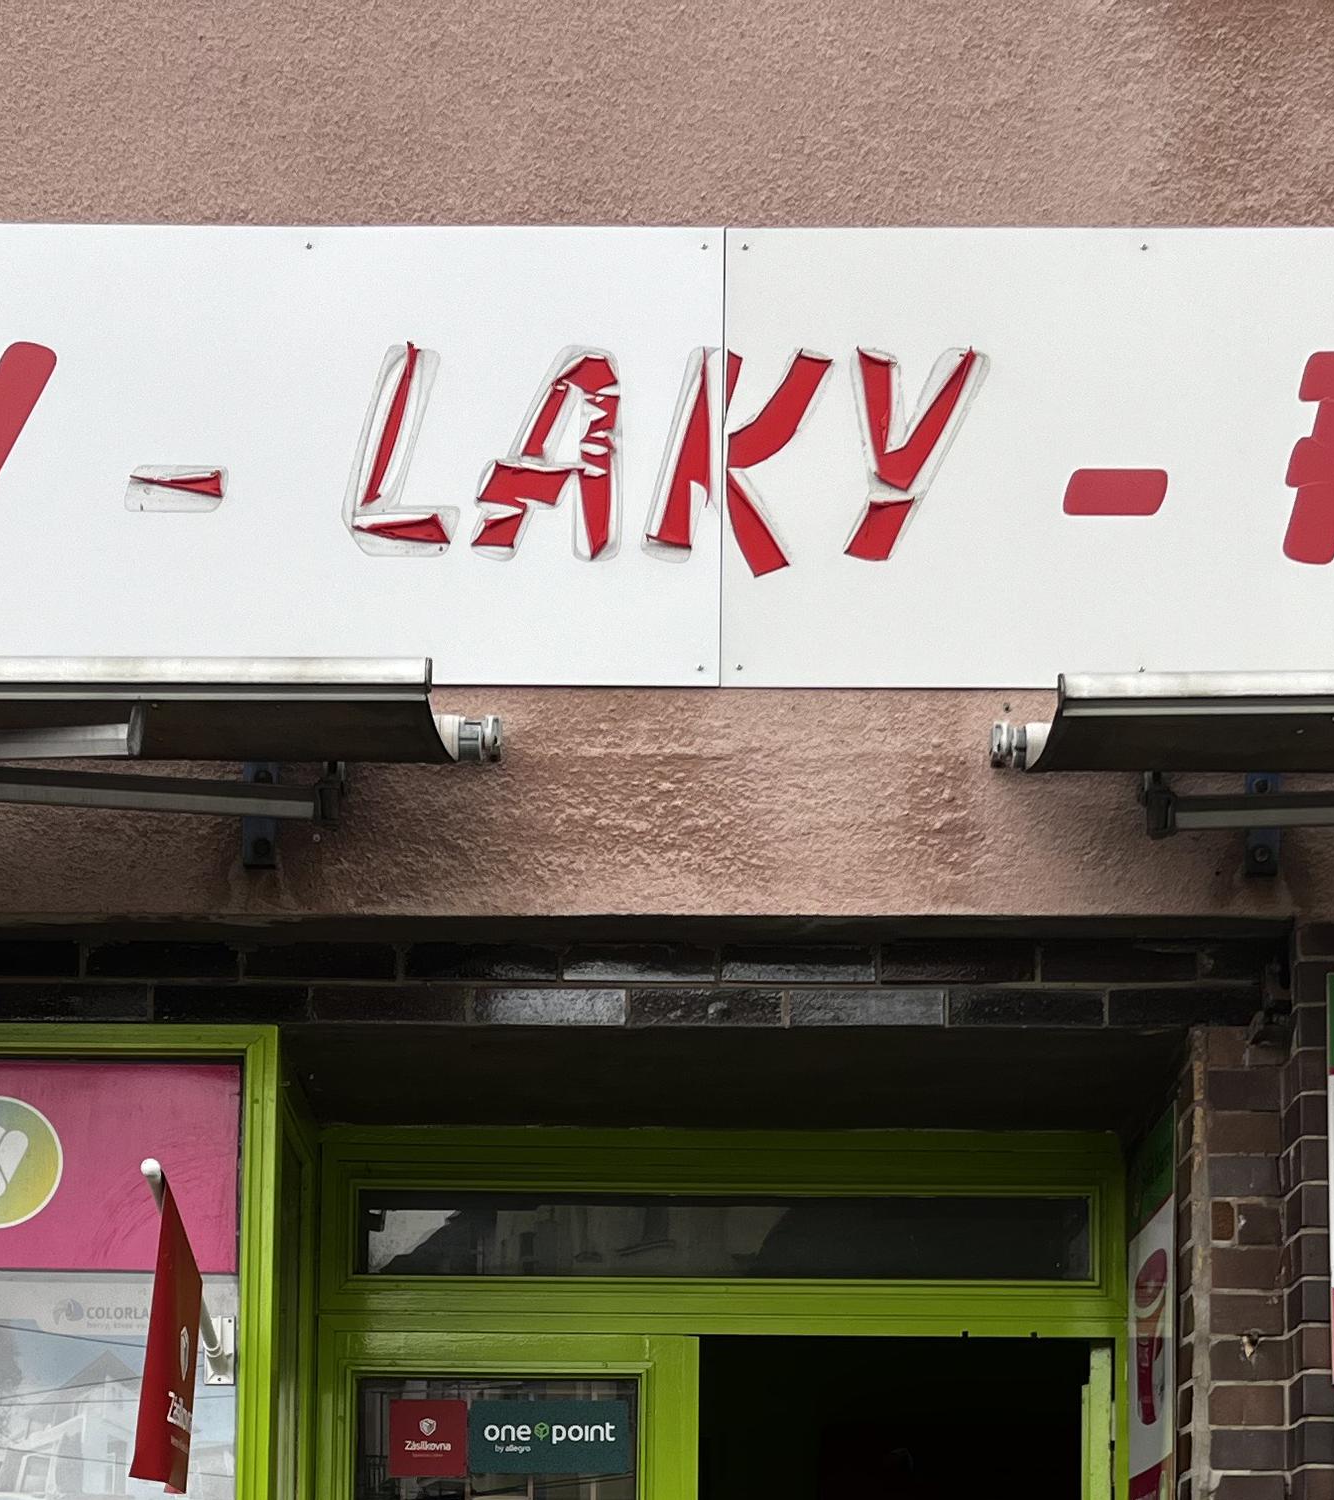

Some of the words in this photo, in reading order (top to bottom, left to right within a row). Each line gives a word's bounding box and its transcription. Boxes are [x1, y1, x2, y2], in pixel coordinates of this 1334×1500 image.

[343, 342, 991, 578] LAKY
[86, 1306, 151, 1320] COLORLA
[483, 1423, 531, 1442] one
[551, 1421, 616, 1445] point
[404, 1440, 452, 1452] Zásilkovna
